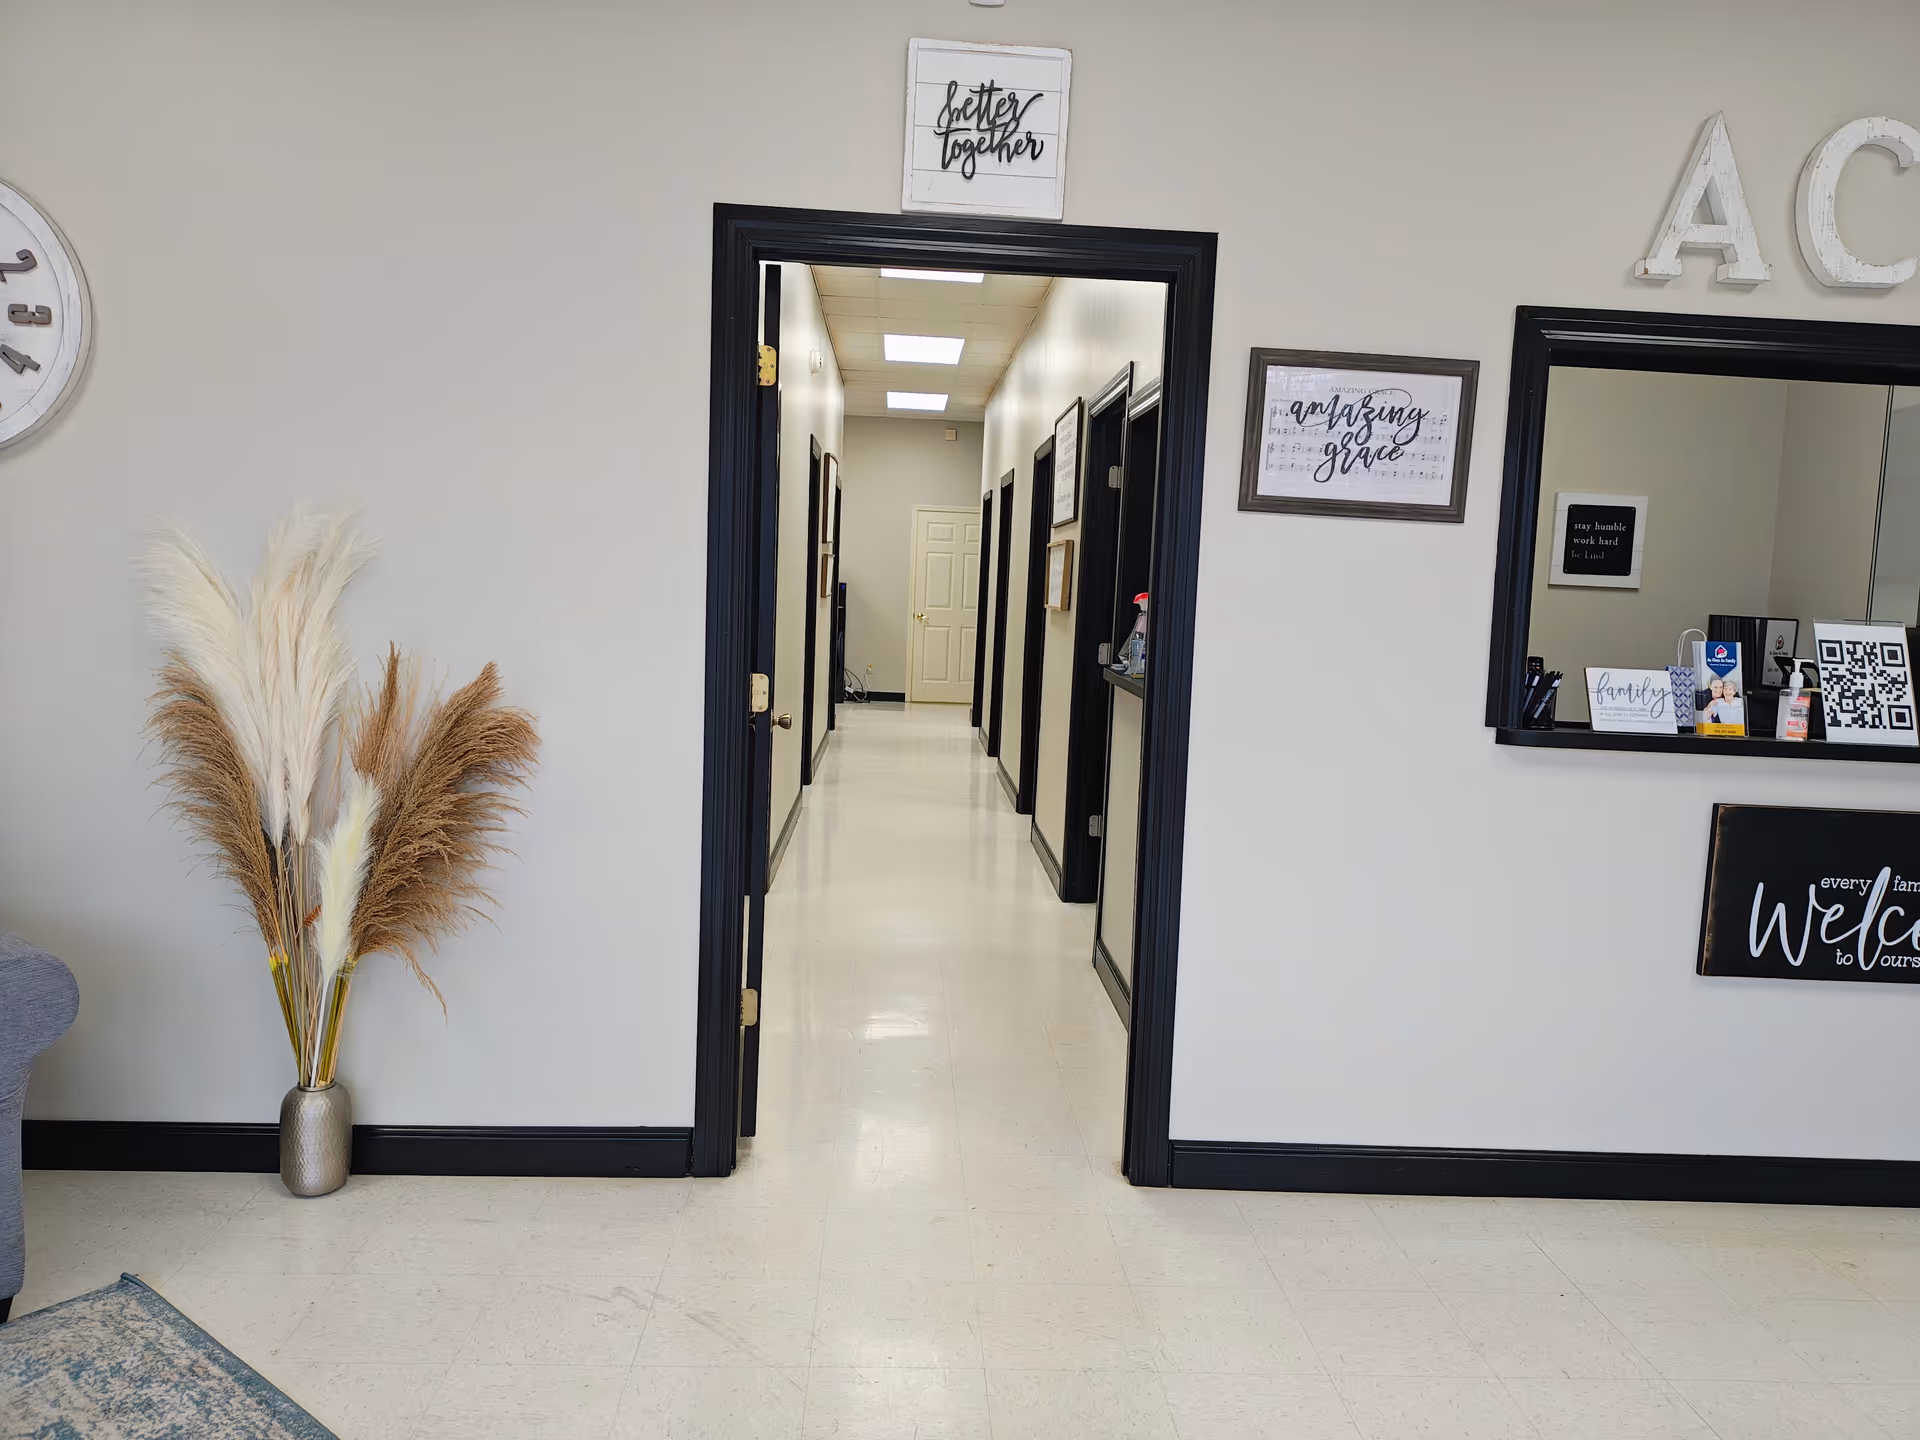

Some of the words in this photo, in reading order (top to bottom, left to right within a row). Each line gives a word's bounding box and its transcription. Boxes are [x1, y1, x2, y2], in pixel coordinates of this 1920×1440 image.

[937, 79, 1044, 132] better
[933, 119, 1044, 180] together
[1329, 386, 1367, 394] AMAZING
[1368, 388, 1394, 396] GRACE
[1290, 388, 1430, 446] amazing
[1314, 431, 1405, 483] grace
[1573, 522, 1592, 532] stay
[1594, 521, 1627, 532] humble
[1573, 535, 1595, 545] work
[1598, 536, 1619, 546] hard
[1591, 672, 1672, 719] family
[1820, 876, 1873, 896] every
[1836, 948, 1854, 966] to
